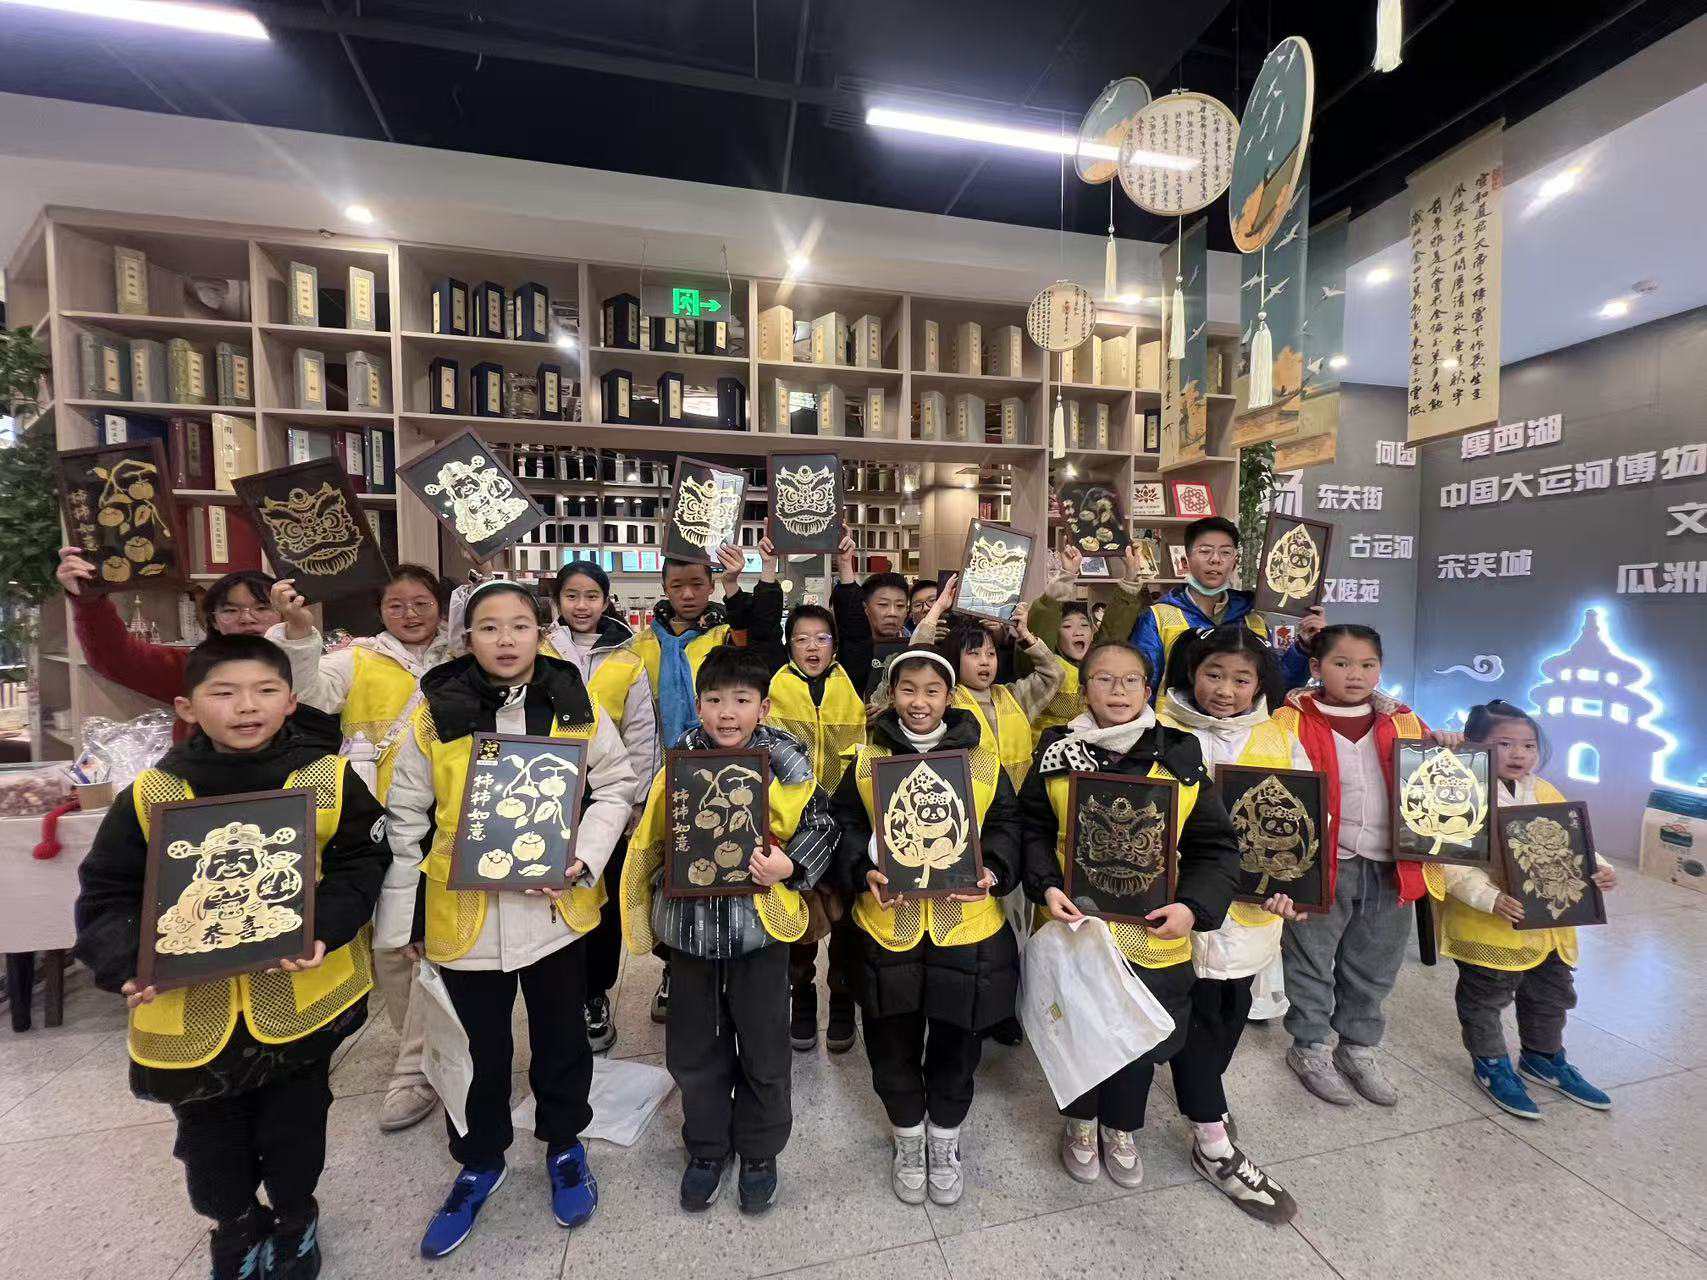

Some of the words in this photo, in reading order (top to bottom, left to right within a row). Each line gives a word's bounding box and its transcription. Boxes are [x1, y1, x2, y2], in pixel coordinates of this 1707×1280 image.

[1460, 413, 1563, 460] 瘦西湖
[1440, 443, 1707, 509] 中国大运河博物
[1315, 483, 1383, 511] 东关街
[1348, 532, 1415, 560] 古运河
[1437, 549, 1533, 580] 宋夹城
[1617, 560, 1707, 594] 瓜洲
[466, 772, 498, 841] 柿柿如意
[672, 788, 691, 852] 柿柿如意
[201, 914, 264, 945] 恭喜
